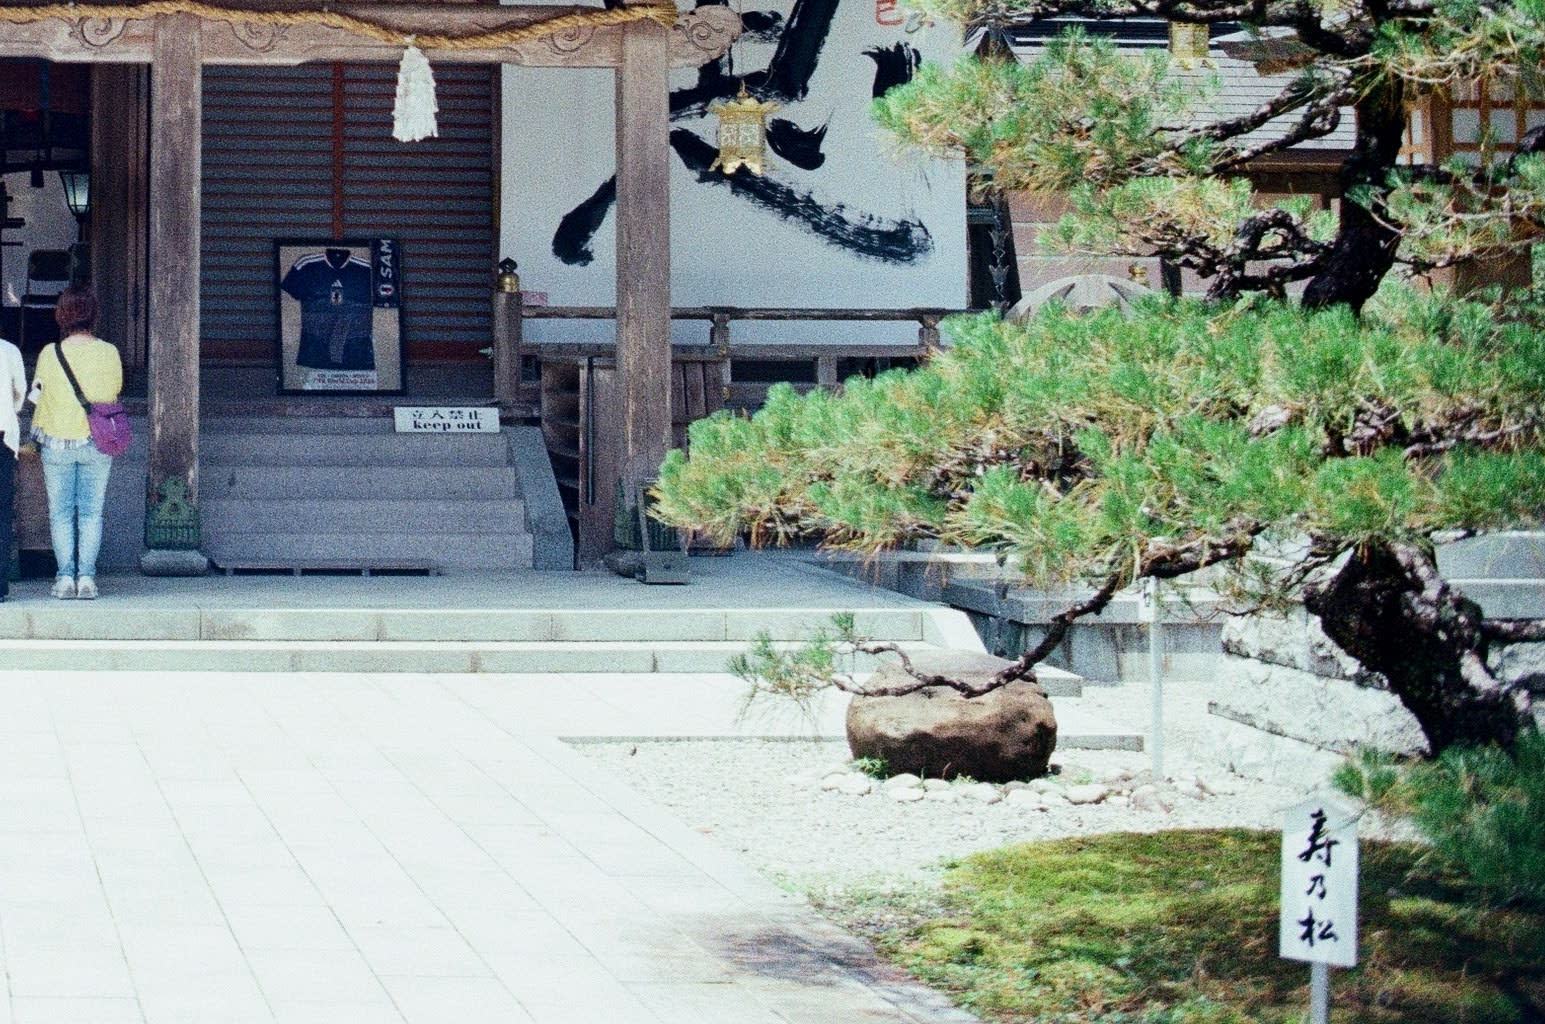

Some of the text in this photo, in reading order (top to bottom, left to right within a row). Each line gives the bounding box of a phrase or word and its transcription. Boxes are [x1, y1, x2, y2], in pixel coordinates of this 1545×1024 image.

[412, 410, 483, 420] 立入禁止
[413, 420, 482, 431] keep out
[1297, 808, 1340, 948] 寿乃松
